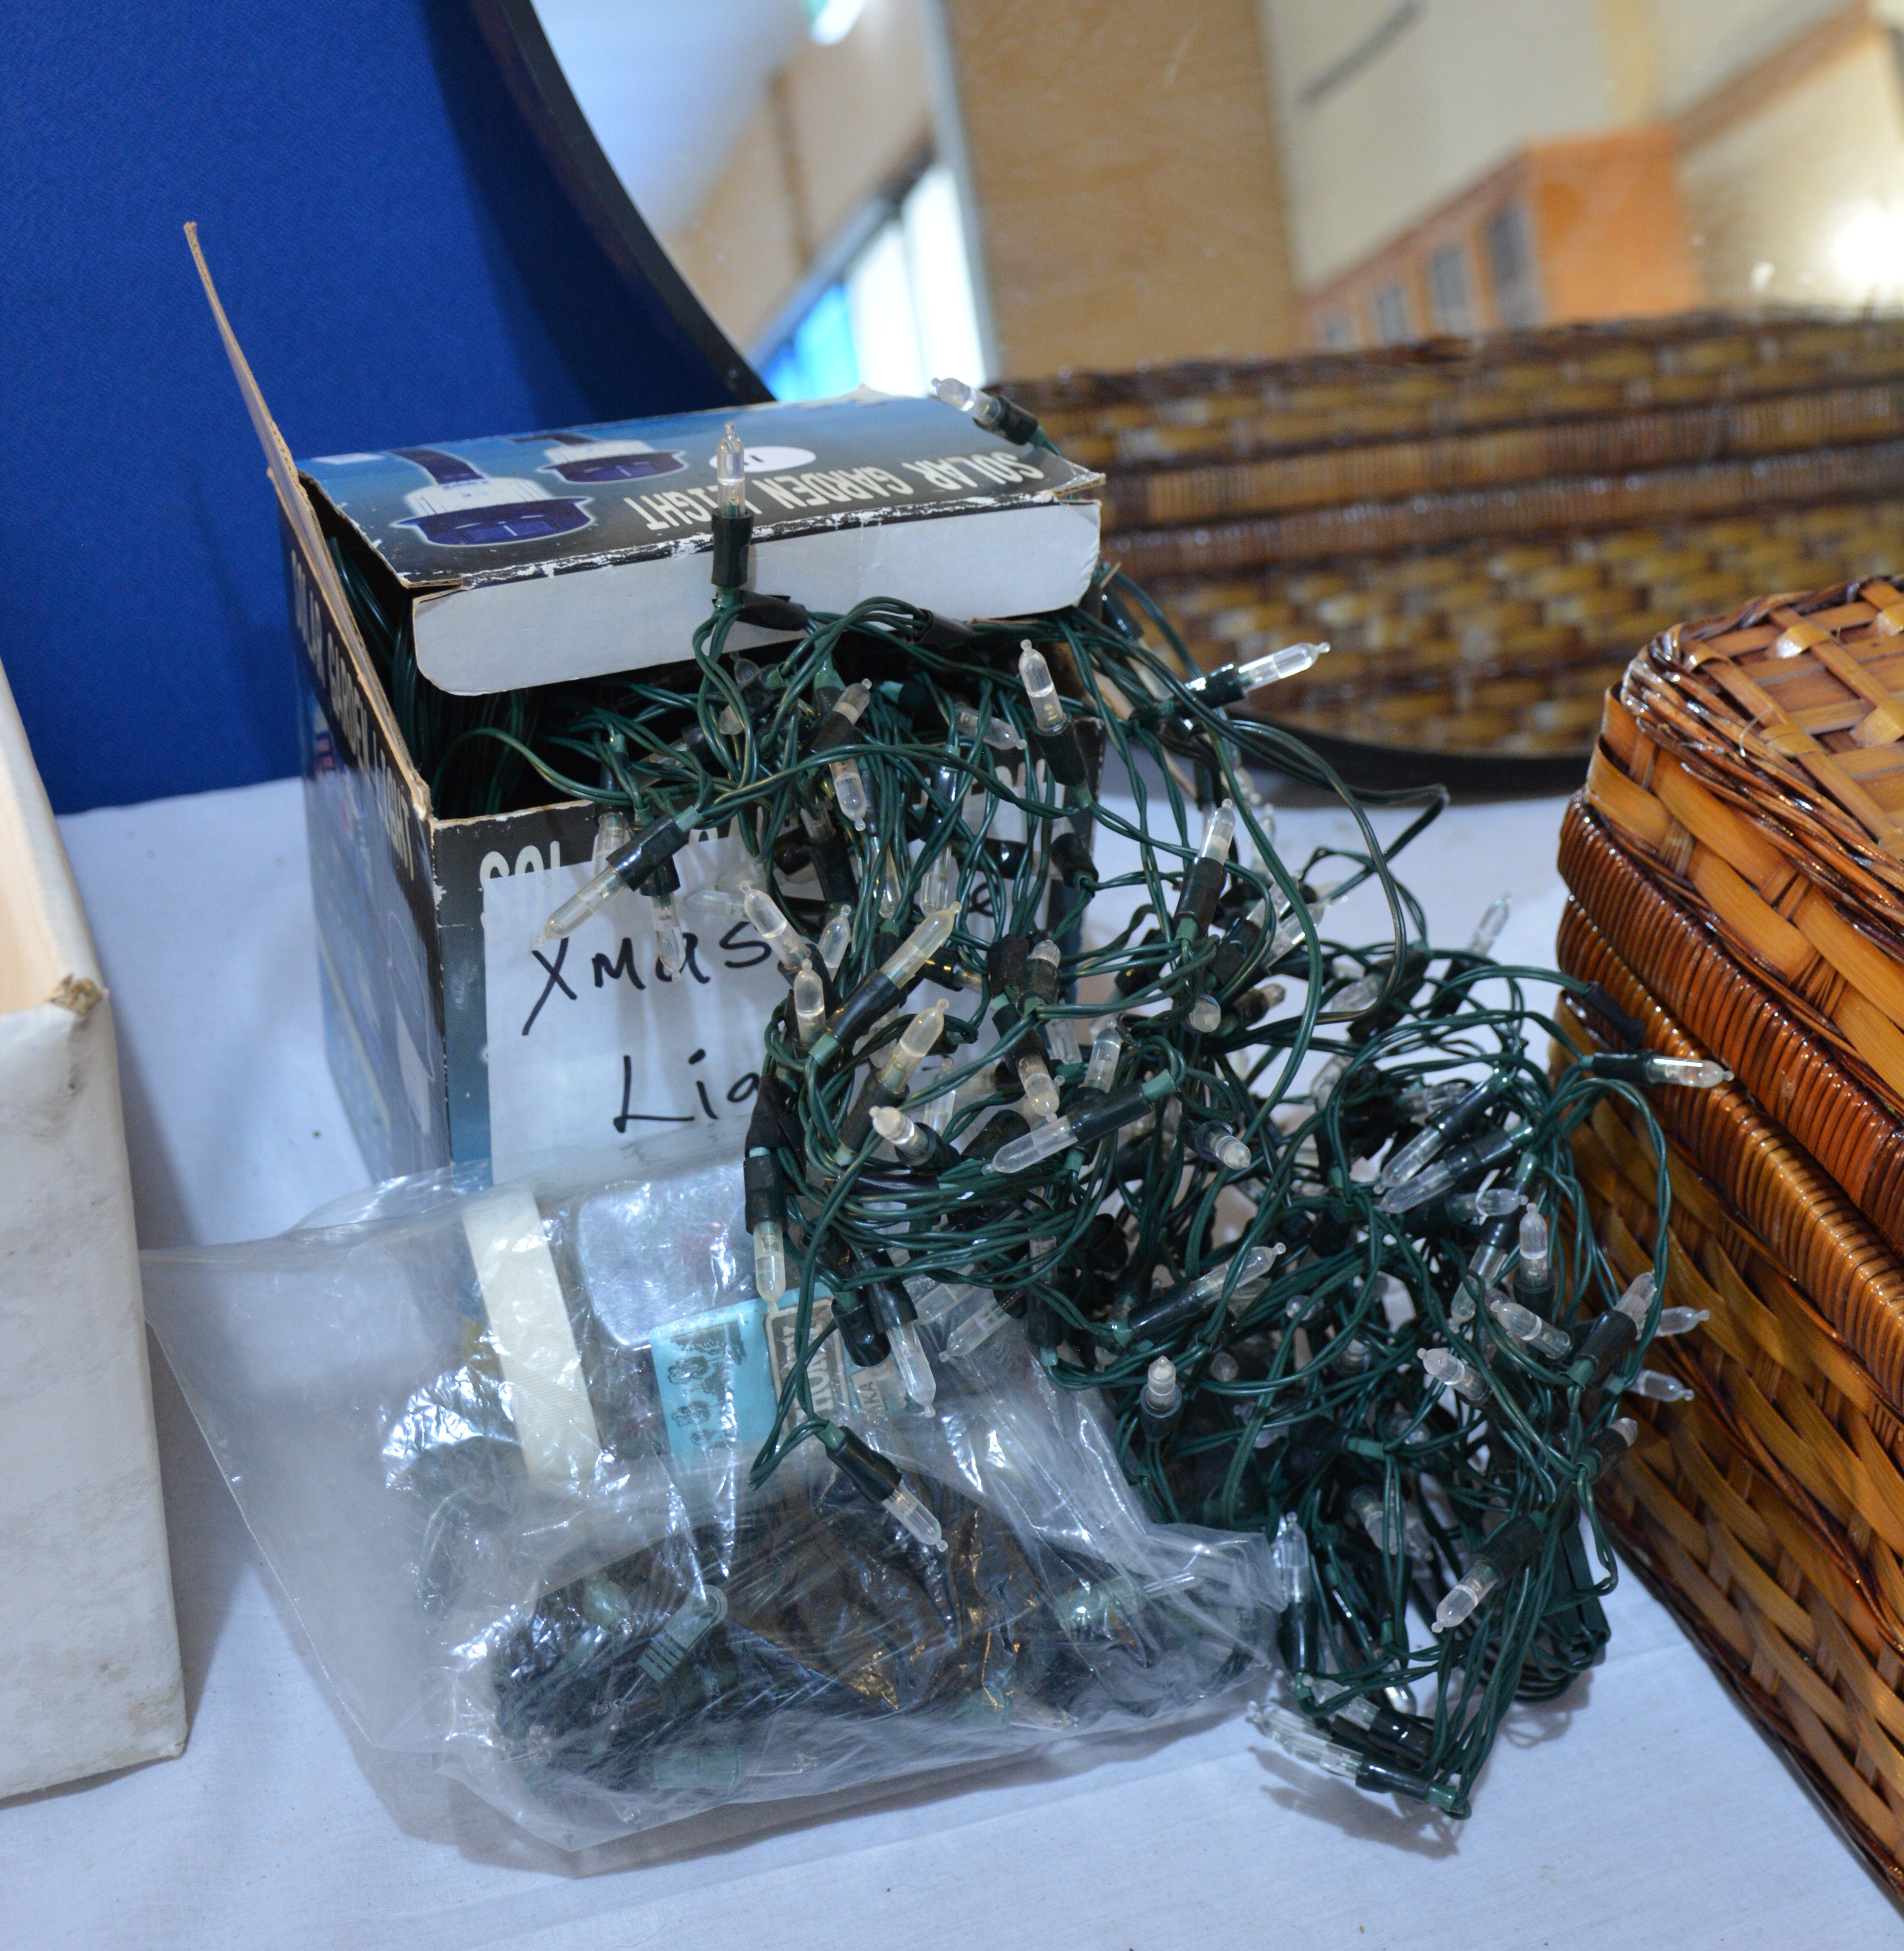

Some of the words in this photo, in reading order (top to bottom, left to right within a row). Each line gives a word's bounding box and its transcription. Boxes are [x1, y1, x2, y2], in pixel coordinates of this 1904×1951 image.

[751, 466, 914, 509] GARDEN
[902, 451, 1044, 490] SOLAR
[371, 729, 415, 881] LIGHT
